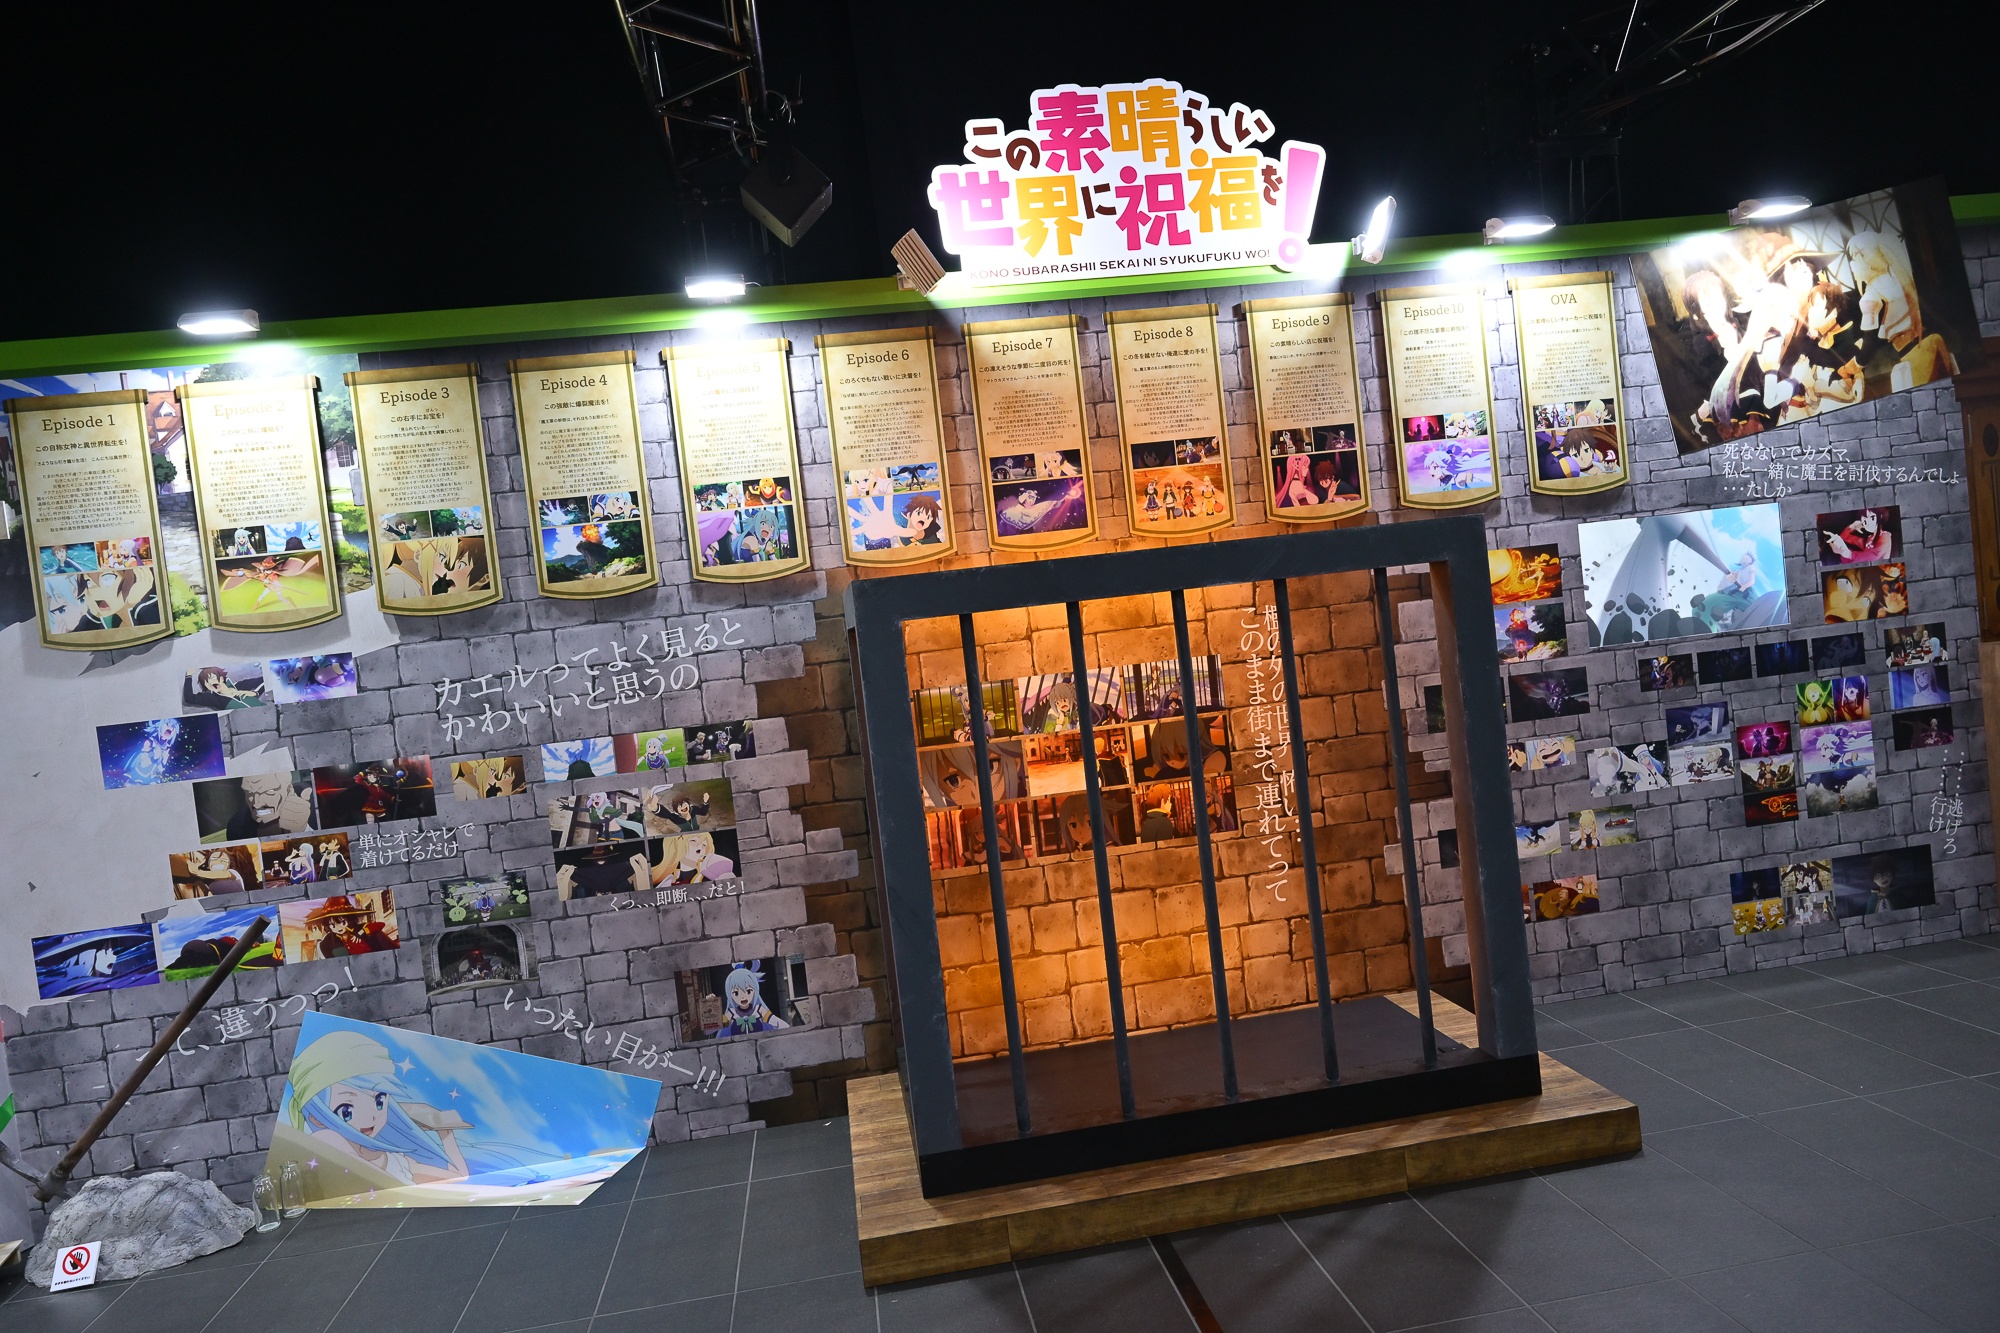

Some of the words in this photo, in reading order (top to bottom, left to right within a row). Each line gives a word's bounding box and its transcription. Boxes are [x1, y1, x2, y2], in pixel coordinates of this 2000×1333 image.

[971, 85, 1268, 173] この素晴らしい
[968, 265, 1010, 281] KONO
[1012, 260, 1098, 279] SUBARASHII
[1099, 257, 1140, 272] SEKAI
[1142, 256, 1157, 268] NI
[1159, 250, 1242, 267] SYUKUFUKU
[1550, 293, 1578, 306] OVA
[1404, 304, 1450, 320] Episode
[1452, 302, 1464, 314] 10
[1272, 316, 1320, 332] Episode
[1322, 314, 1330, 326] 9
[1134, 327, 1182, 344] Episode
[1185, 326, 1194, 337] 8
[992, 338, 1042, 356] Episode
[1046, 337, 1053, 348] 7
[846, 350, 898, 368] Episode
[901, 349, 910, 361] 6
[540, 375, 596, 394] Episode
[599, 374, 608, 386] 4
[839, 372, 922, 384] このろくでもない戦いに決着を!
[380, 388, 438, 406] Episode
[441, 386, 450, 399] 3
[213, 402, 273, 420] Episode
[276, 400, 286, 412] 2
[41, 414, 103, 434] Episode
[107, 414, 116, 426] 1
[36, 438, 128, 453] この自称女神と異世界転生を!
[1722, 442, 1852, 463] 死なないでカズマ、
[1722, 461, 1960, 485] 私と一緒に魔王を討伐するんでしょ
[435, 617, 745, 711] カエルってよく見ると
[440, 662, 700, 742] かわいいと思うの
[1240, 606, 1288, 902] このまま街まで連れてって
[358, 822, 476, 851] 単にオシャレで
[360, 840, 459, 868] 着けてるだけ
